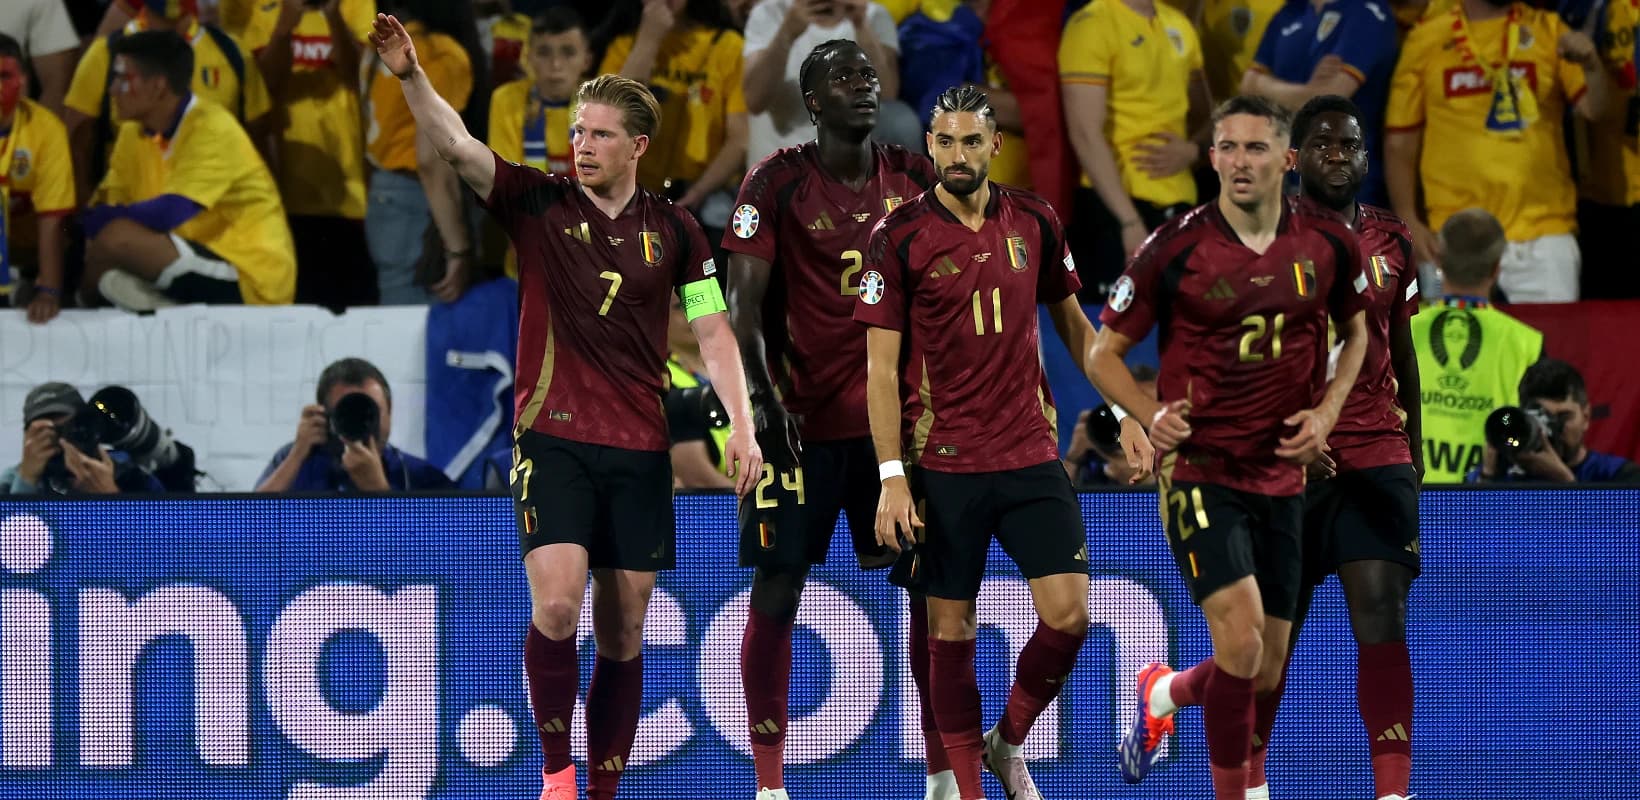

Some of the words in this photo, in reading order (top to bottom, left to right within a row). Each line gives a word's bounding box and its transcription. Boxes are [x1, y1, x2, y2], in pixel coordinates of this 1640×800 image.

[1450, 67, 1527, 91] PEY
[598, 270, 623, 316] 7
[972, 287, 1003, 336] 11
[1239, 312, 1285, 362] 21
[516, 458, 534, 502] 7
[756, 462, 806, 509] 24
[1169, 486, 1210, 541] 21
